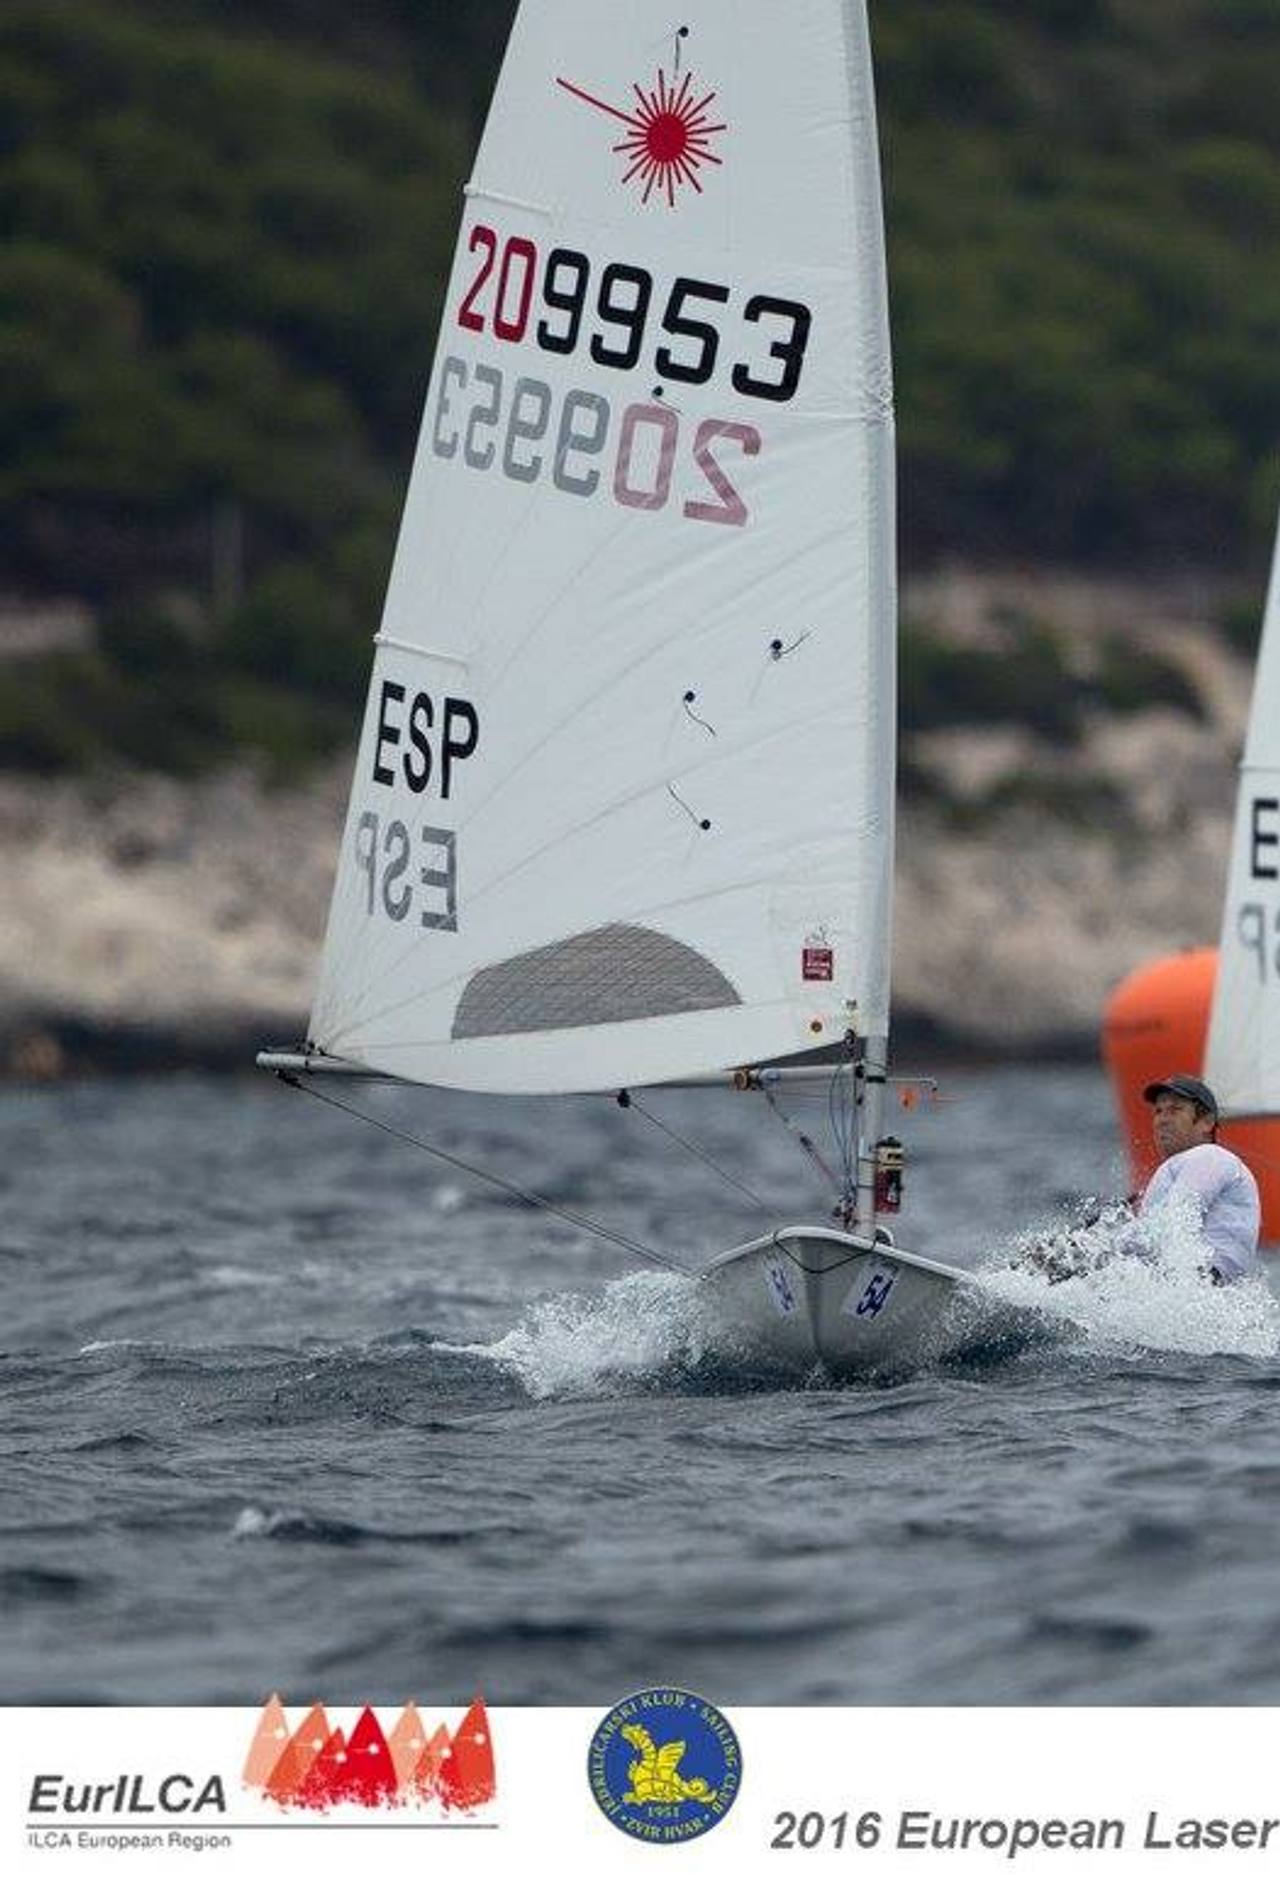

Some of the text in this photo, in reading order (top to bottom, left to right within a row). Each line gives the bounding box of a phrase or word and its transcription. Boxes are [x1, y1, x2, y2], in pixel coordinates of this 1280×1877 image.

[457, 225, 812, 402] 209953
[373, 680, 480, 800] ESP
[856, 1274, 894, 1320] 54
